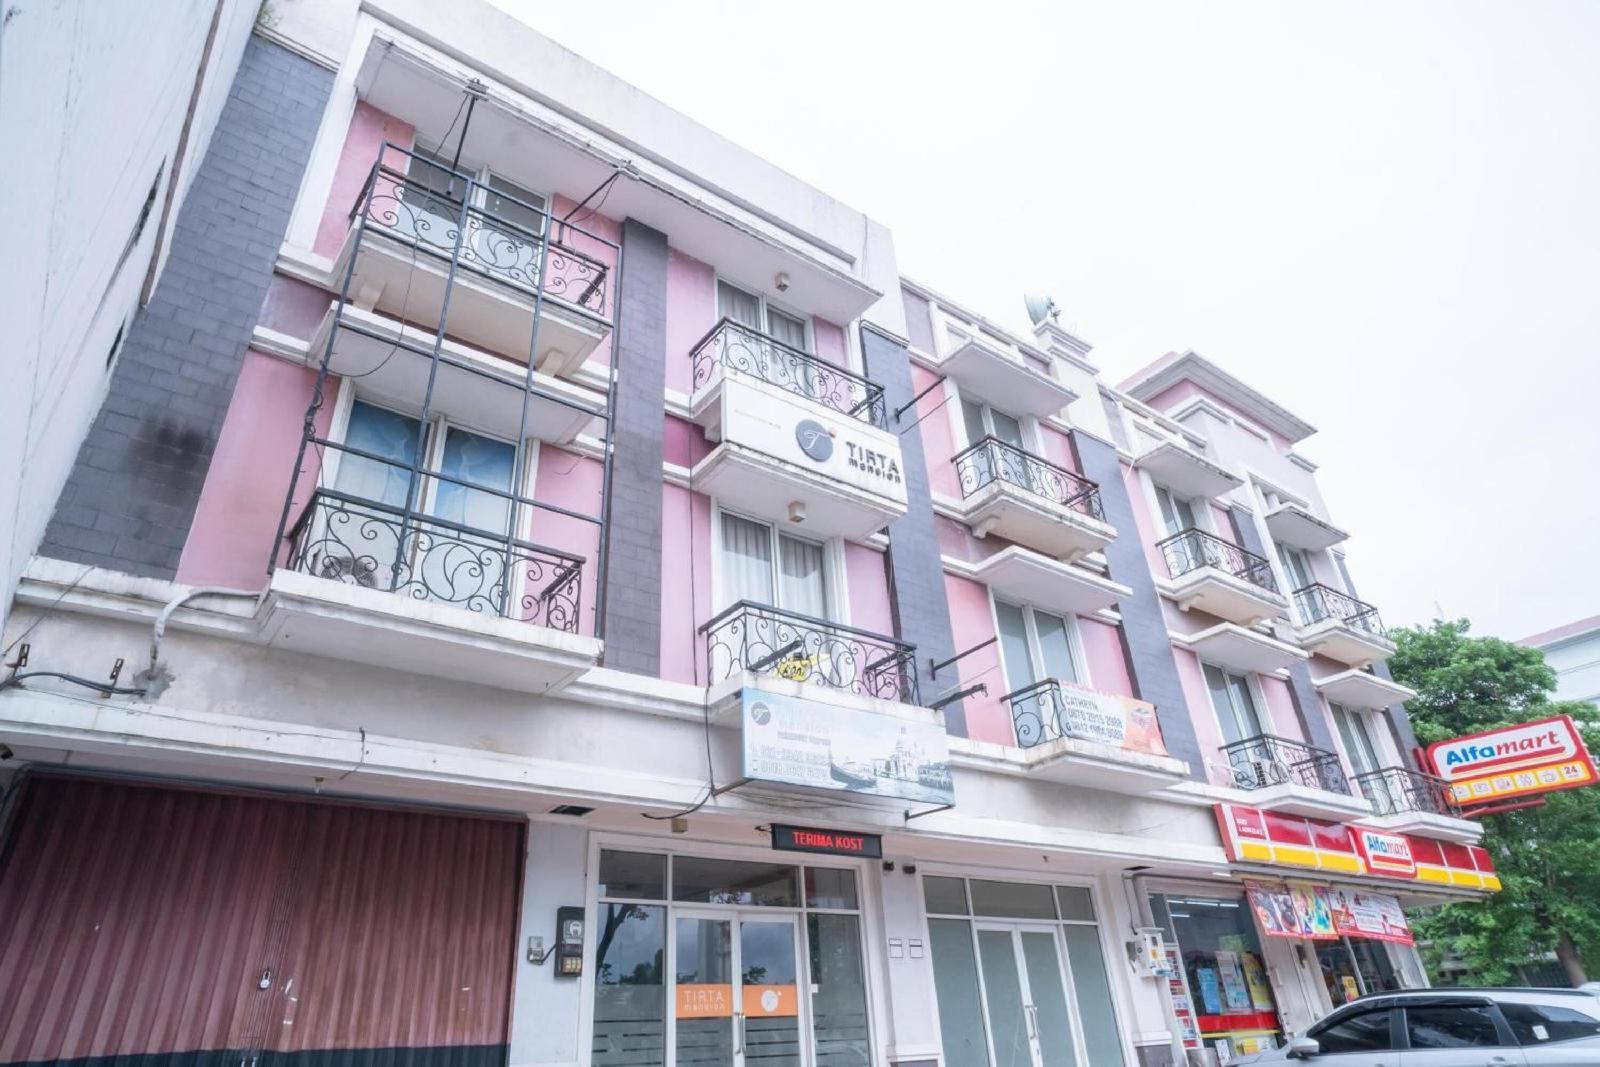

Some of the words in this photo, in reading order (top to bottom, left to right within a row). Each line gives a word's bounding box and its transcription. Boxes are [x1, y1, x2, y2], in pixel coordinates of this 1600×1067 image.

[846, 441, 899, 474] TIRTA
[848, 457, 901, 484] mansion
[1446, 731, 1560, 765] Alfamart
[1563, 765, 1578, 775] 24
[793, 831, 833, 848] TERIMA
[835, 835, 863, 850] KOST
[1366, 834, 1409, 857] Alfamart
[683, 990, 724, 1003] TIRTA
